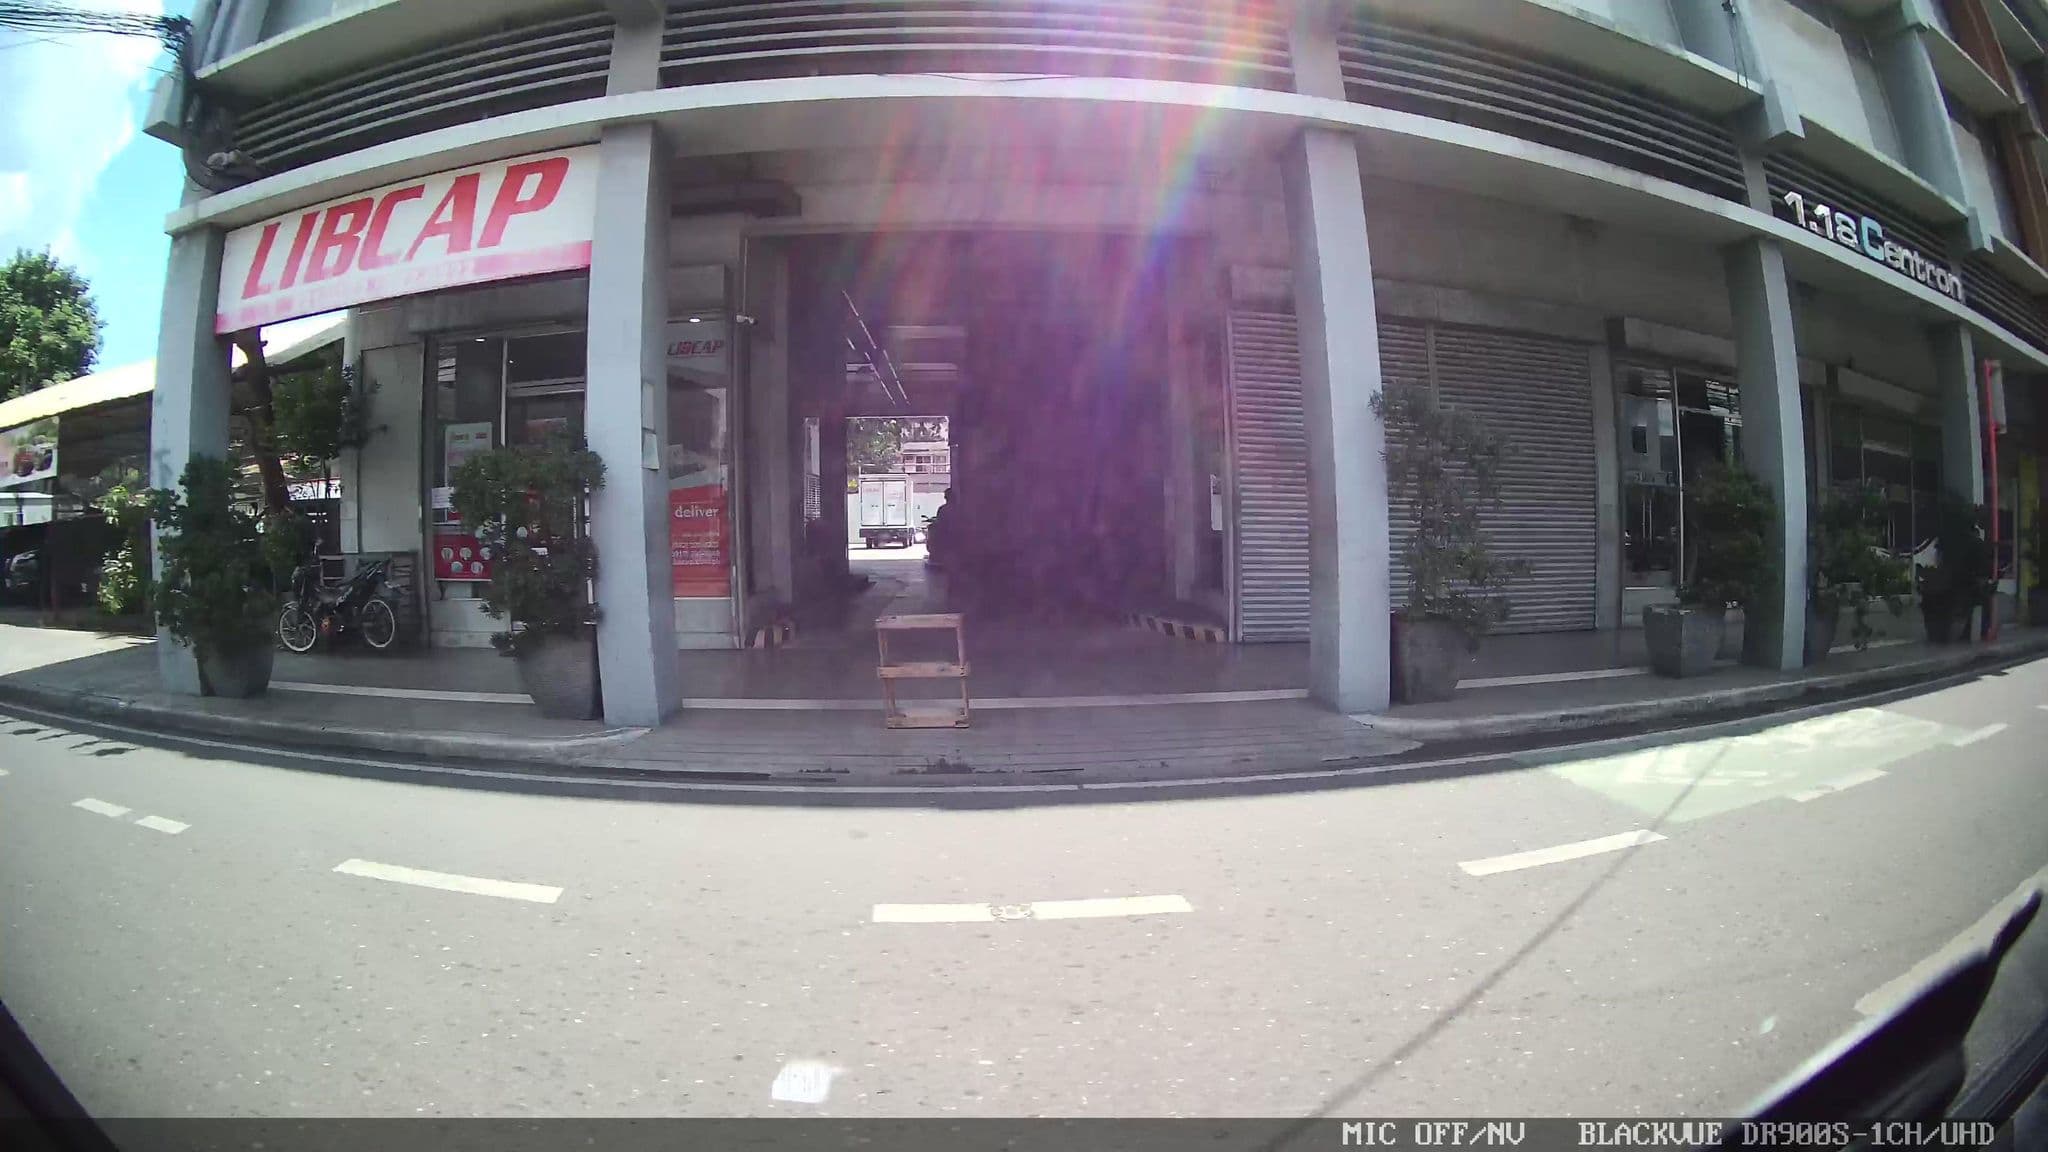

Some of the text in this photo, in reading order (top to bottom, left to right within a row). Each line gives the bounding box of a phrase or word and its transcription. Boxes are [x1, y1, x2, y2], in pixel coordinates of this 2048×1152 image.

[242, 157, 570, 300] LIBCAP
[1784, 191, 1964, 300] 1.18 Centron
[675, 505, 719, 518] deliver
